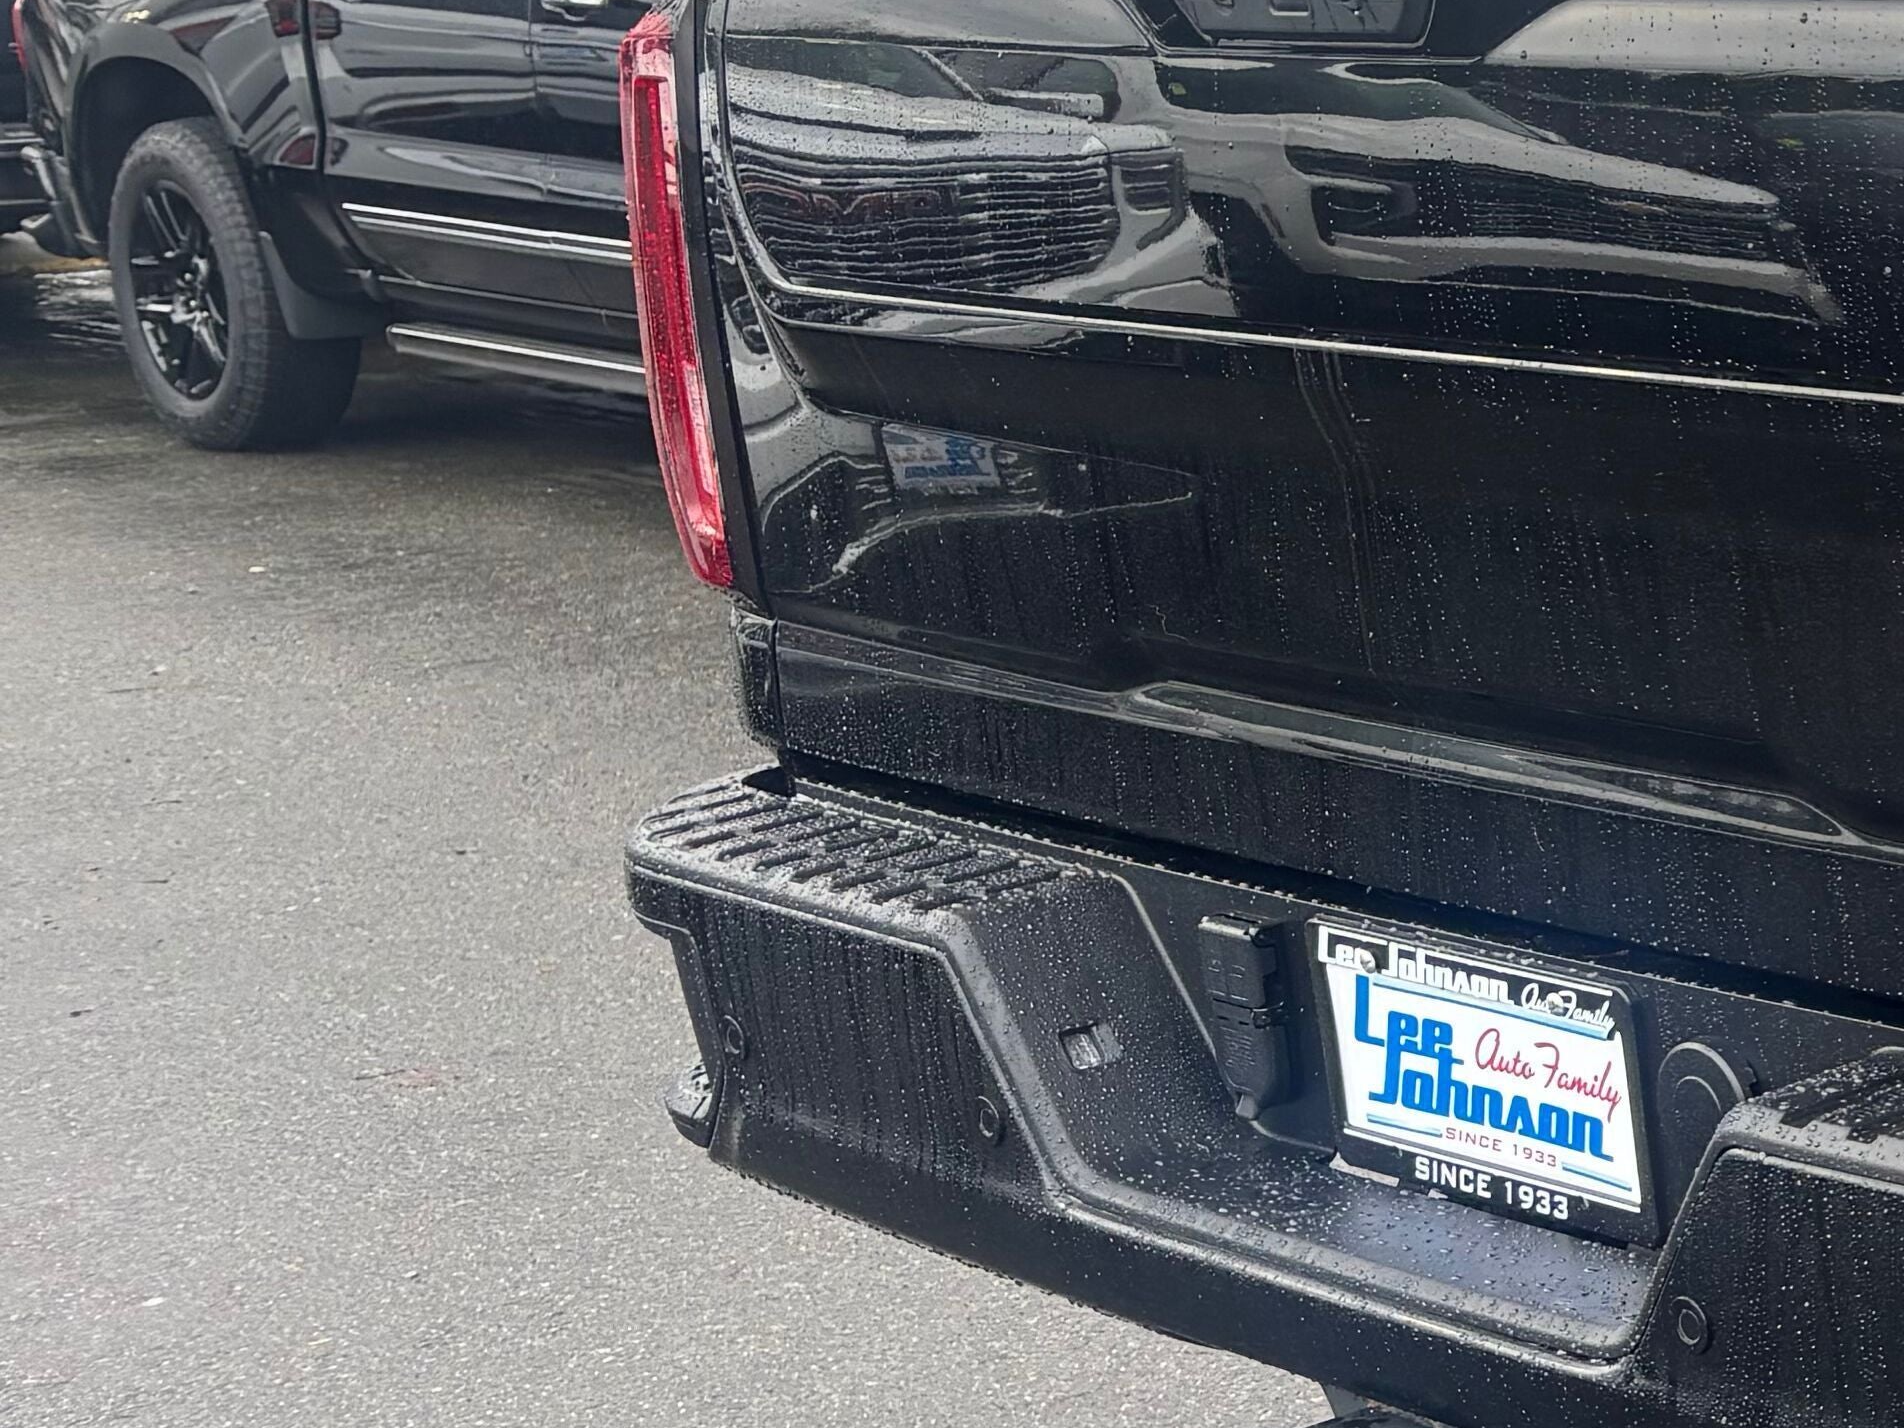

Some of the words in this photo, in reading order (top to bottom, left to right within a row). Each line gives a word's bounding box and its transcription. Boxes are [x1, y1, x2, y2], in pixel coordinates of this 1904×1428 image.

[1381, 941, 1515, 1005] Johnson
[1521, 982, 1563, 1016] Au
[1558, 990, 1615, 1040] Family
[1354, 973, 1458, 1060] Lee
[1474, 1028, 1535, 1080] Auto
[1533, 1041, 1622, 1123] Family
[1368, 1010, 1614, 1162] Johnson
[1415, 1155, 1492, 1199] SINCE
[1505, 1180, 1568, 1220] 1933
[1445, 1127, 1502, 1152] SINCE
[1513, 1143, 1557, 1167] 1933
